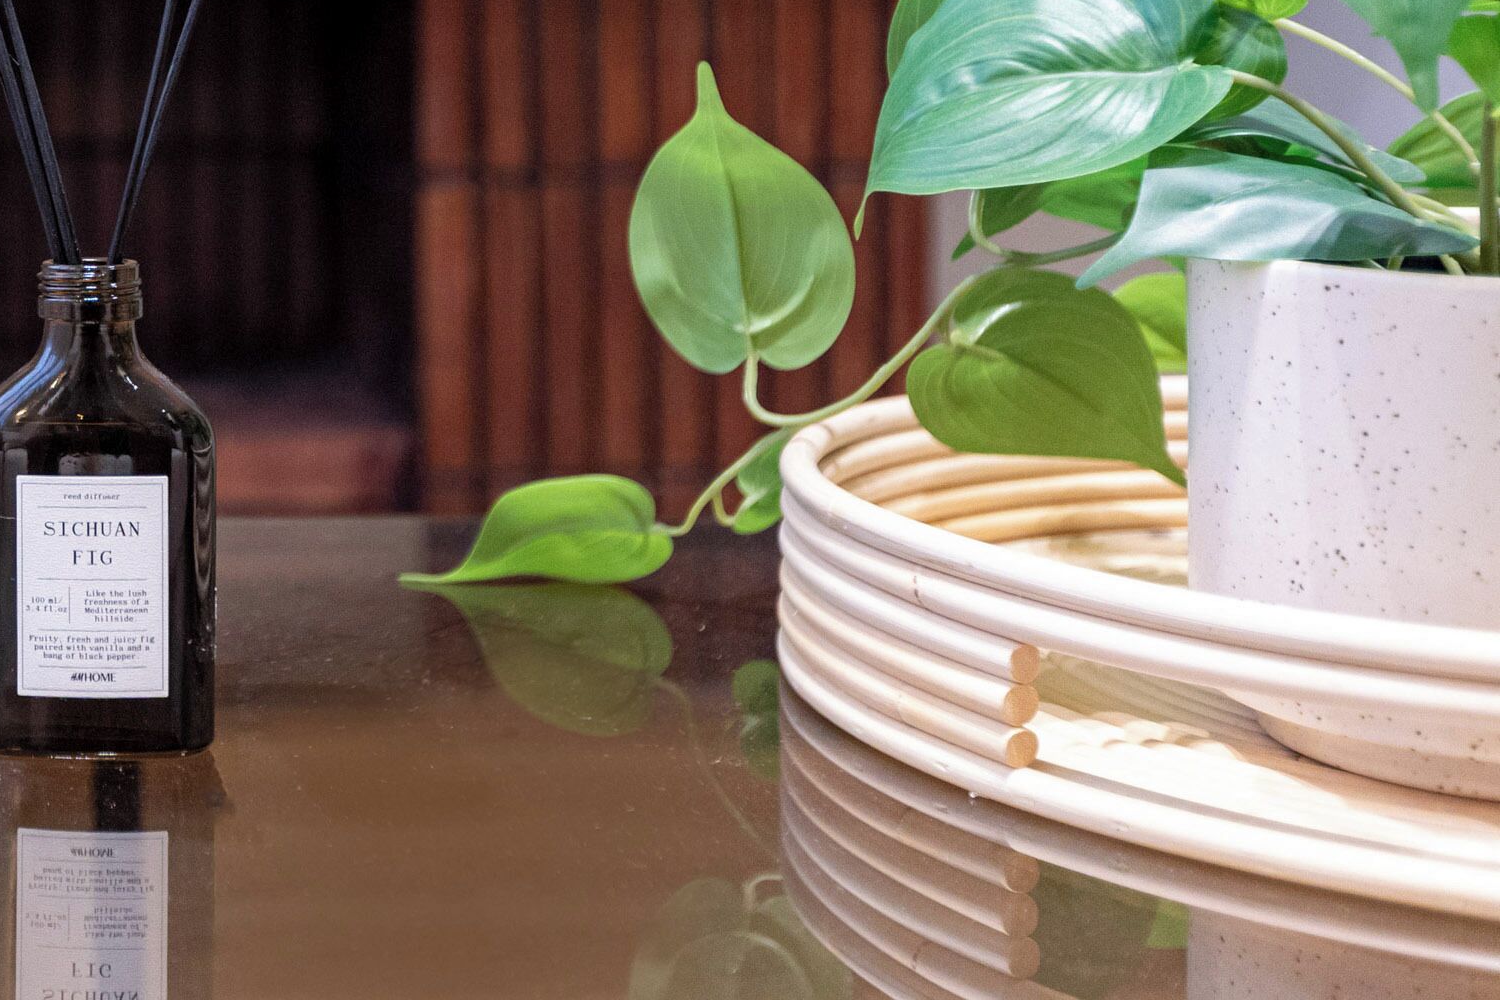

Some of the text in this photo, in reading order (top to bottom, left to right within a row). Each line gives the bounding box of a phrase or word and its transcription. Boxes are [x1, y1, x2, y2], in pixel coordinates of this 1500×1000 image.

[43, 521, 140, 537] SICHUAN
[72, 550, 113, 566] FIG
[128, 589, 147, 597] lush
[67, 635, 91, 643] fresh
[114, 636, 136, 644] juicy
[43, 651, 63, 660] bang
[79, 652, 103, 660] black
